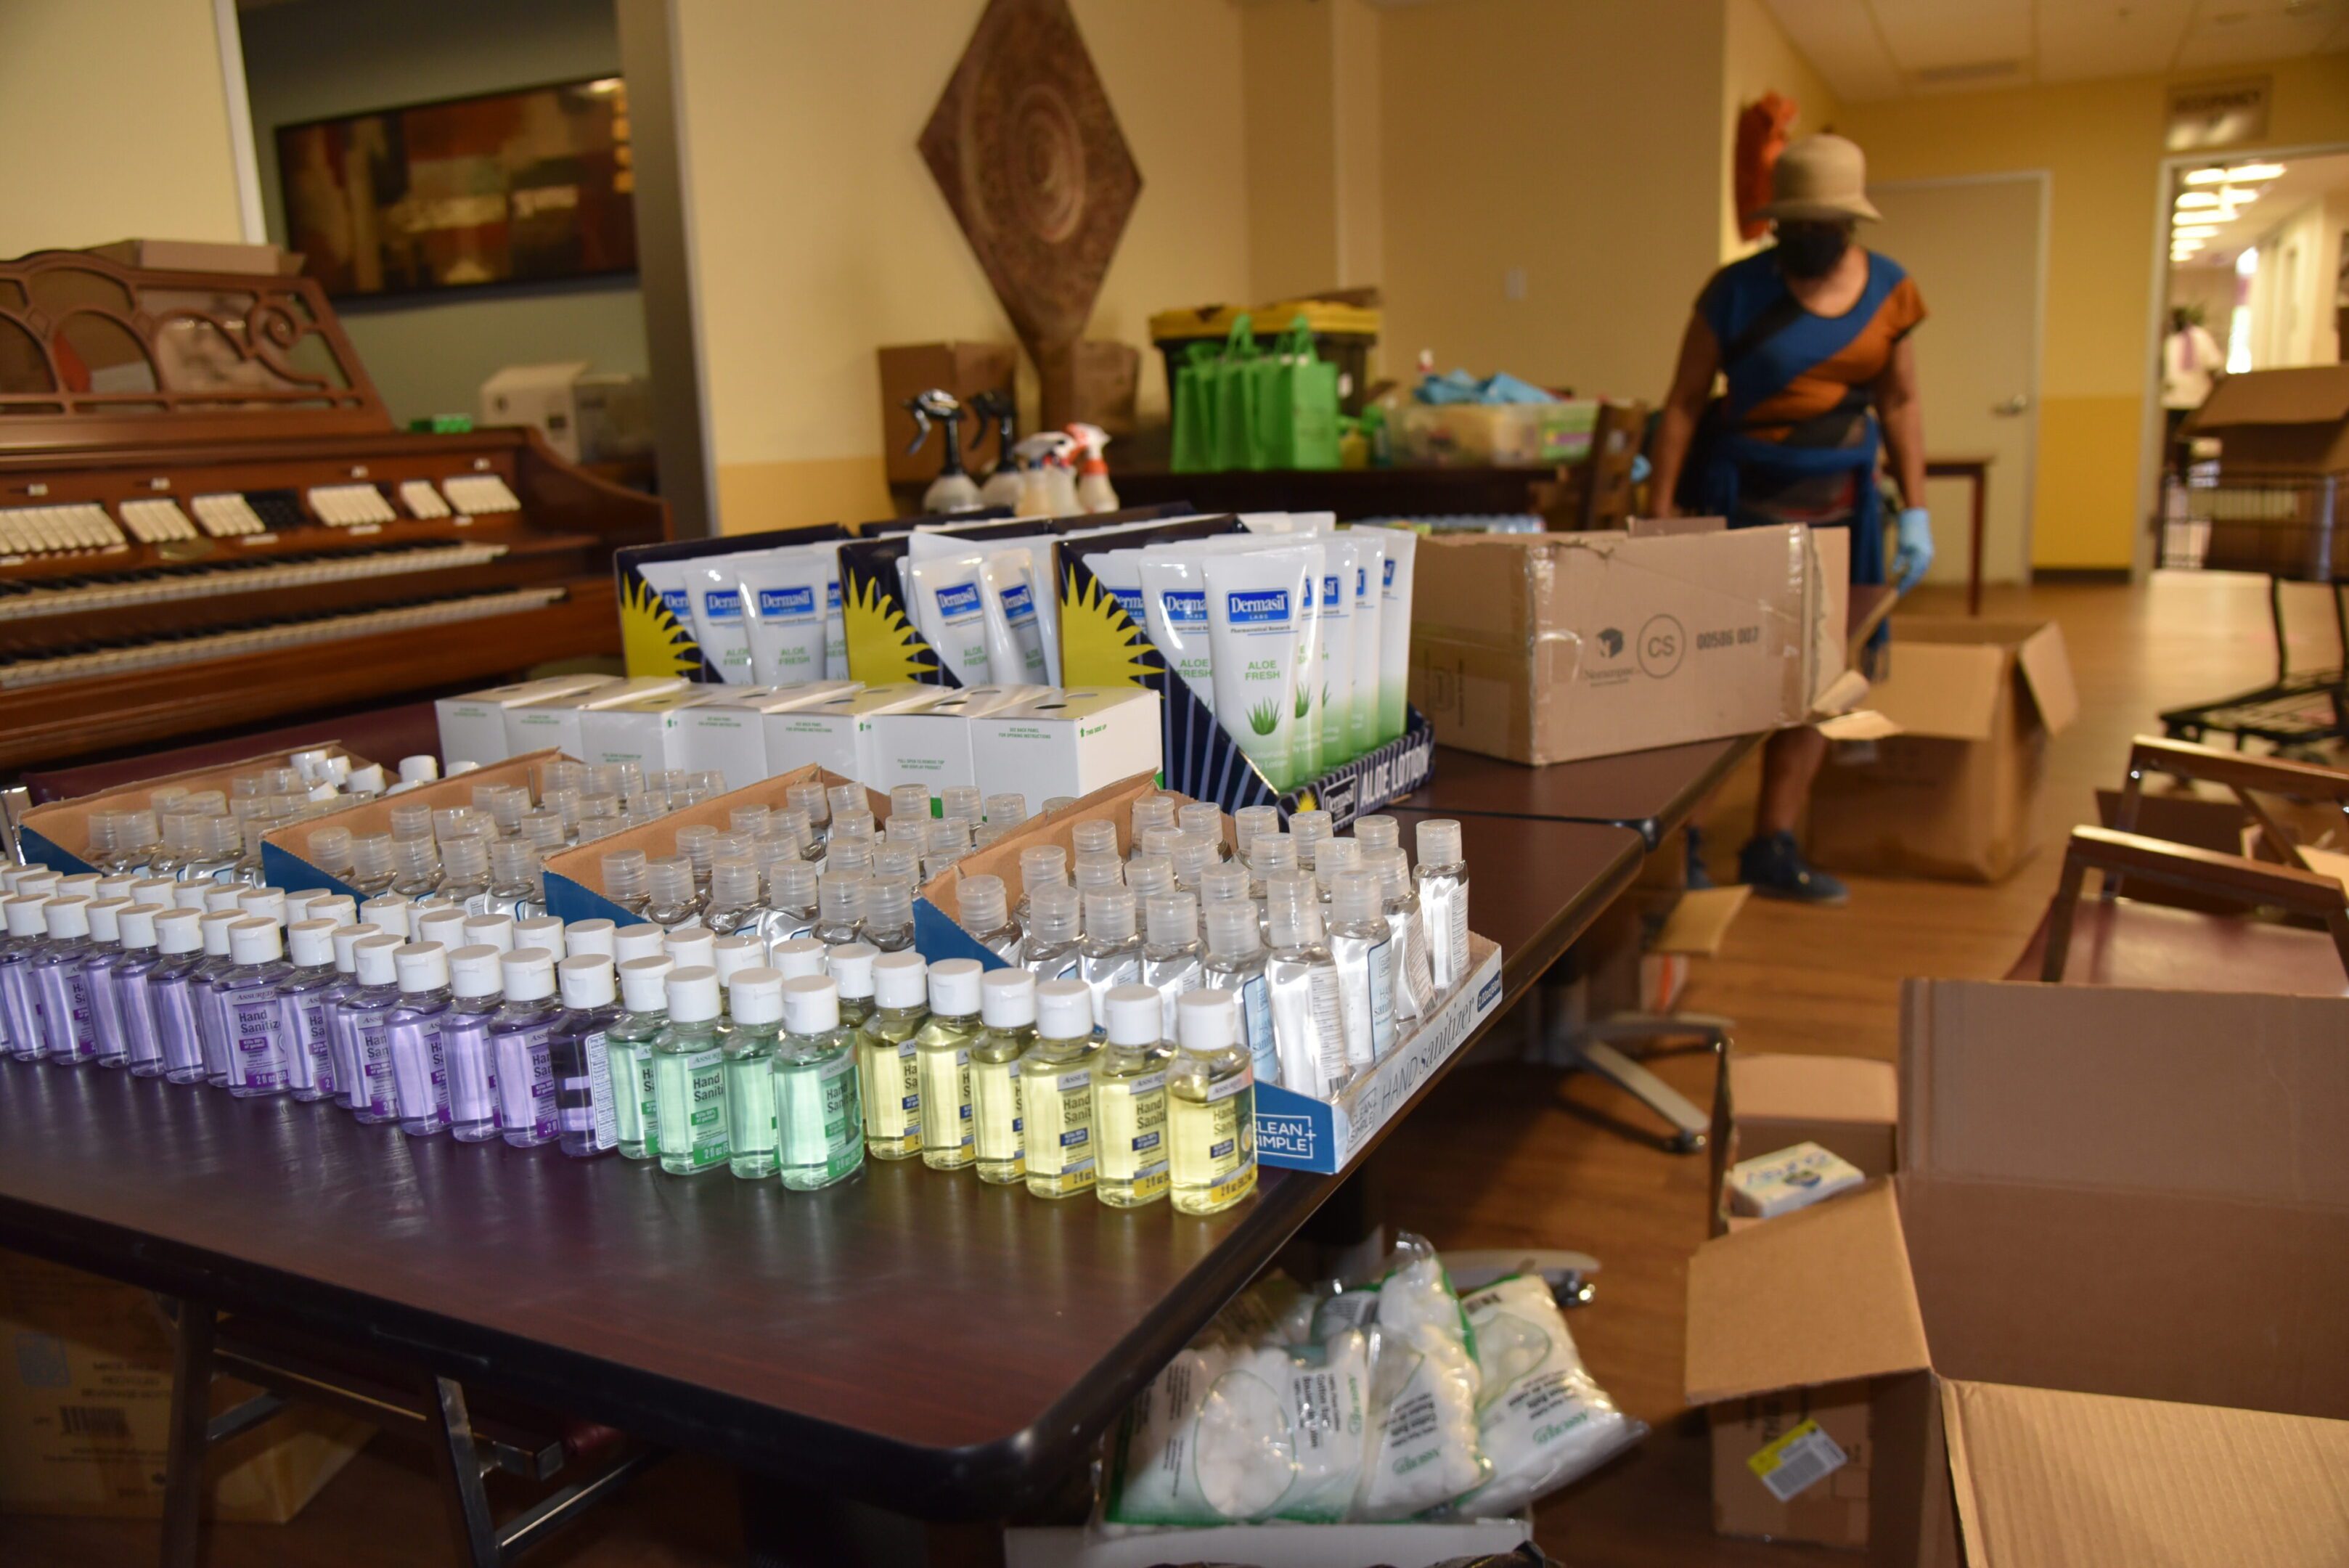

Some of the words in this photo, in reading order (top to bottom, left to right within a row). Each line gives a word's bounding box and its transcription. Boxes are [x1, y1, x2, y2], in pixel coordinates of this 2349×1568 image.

[708, 595, 740, 609] Derm
[762, 590, 810, 608] Dermasil
[1166, 595, 1207, 612] Derma
[1230, 594, 1286, 613] Dermasil
[1647, 634, 1675, 658] CS
[779, 656, 810, 666] FRESH
[1180, 658, 1209, 668] ALOE
[1248, 660, 1277, 670] ALOE
[1177, 669, 1214, 678] FRESH
[1245, 671, 1280, 681] FRESH
[1360, 761, 1389, 808] ALOE
[239, 1009, 268, 1023] Hand
[309, 1016, 323, 1026] Ha
[240, 1019, 281, 1034] Sanitiz
[365, 1035, 387, 1047] Han
[1381, 1056, 1418, 1114] HAND
[1418, 996, 1474, 1076] sanitizer
[904, 1064, 918, 1077] Ha
[256, 1075, 261, 1085] 2
[268, 1074, 276, 1083] oz
[693, 1071, 720, 1090] Hand
[694, 1084, 724, 1103] Saniti
[827, 1083, 849, 1101] Hand
[1063, 1095, 1090, 1111] Hand
[1137, 1097, 1163, 1116] Hand
[1064, 1108, 1092, 1124] Sanit
[704, 1148, 709, 1159] 2
[716, 1146, 722, 1156] oz
[1074, 1175, 1078, 1185] 2
[1146, 1177, 1150, 1188] 2
[1316, 1374, 1328, 1404] Cotton
